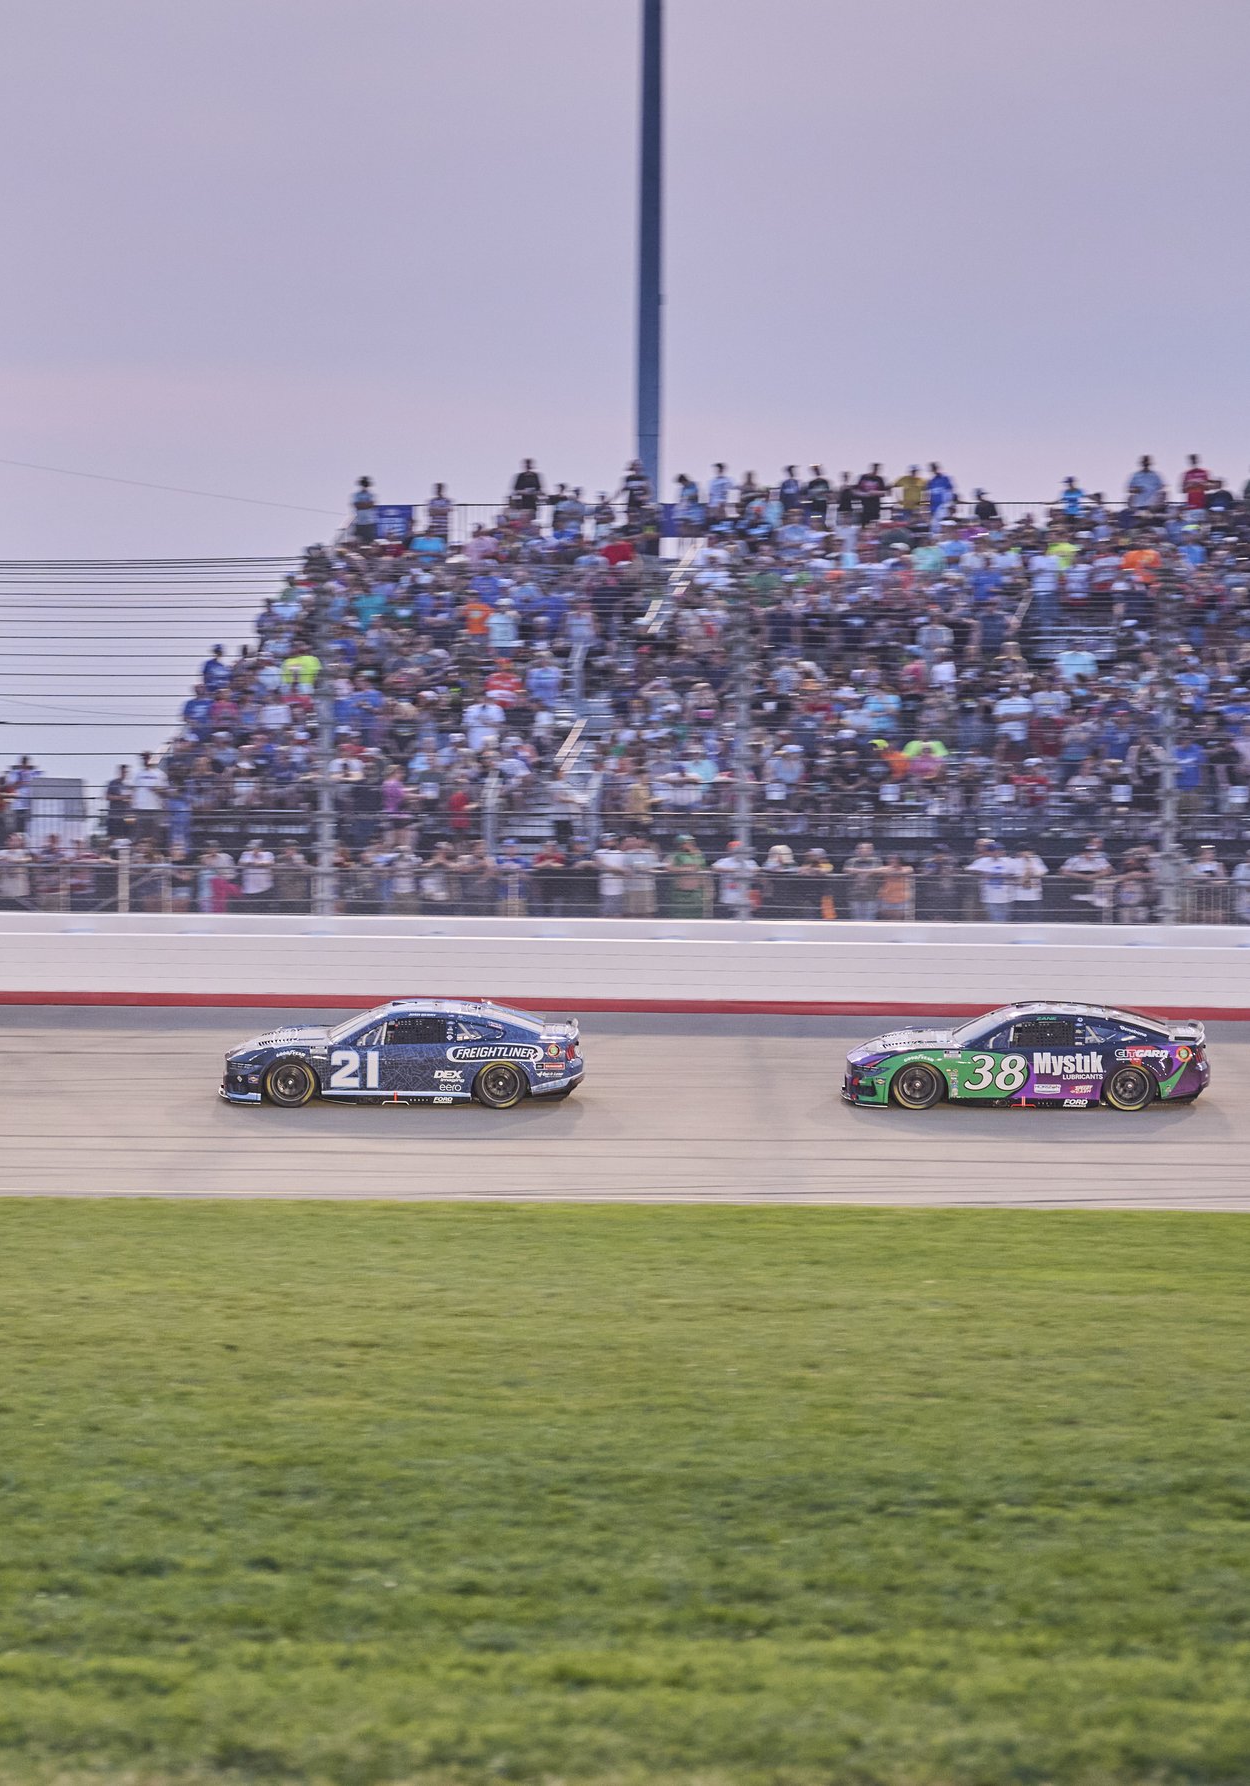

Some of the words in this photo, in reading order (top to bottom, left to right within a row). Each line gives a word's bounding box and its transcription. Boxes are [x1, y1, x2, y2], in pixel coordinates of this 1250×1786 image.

[456, 1046, 534, 1060] FREIGHTLINER
[330, 1051, 379, 1088] 21
[963, 1053, 1029, 1092] 38
[1033, 1052, 1104, 1076] Mystik
[433, 1070, 463, 1079] DEX
[439, 1083, 462, 1092] eero
